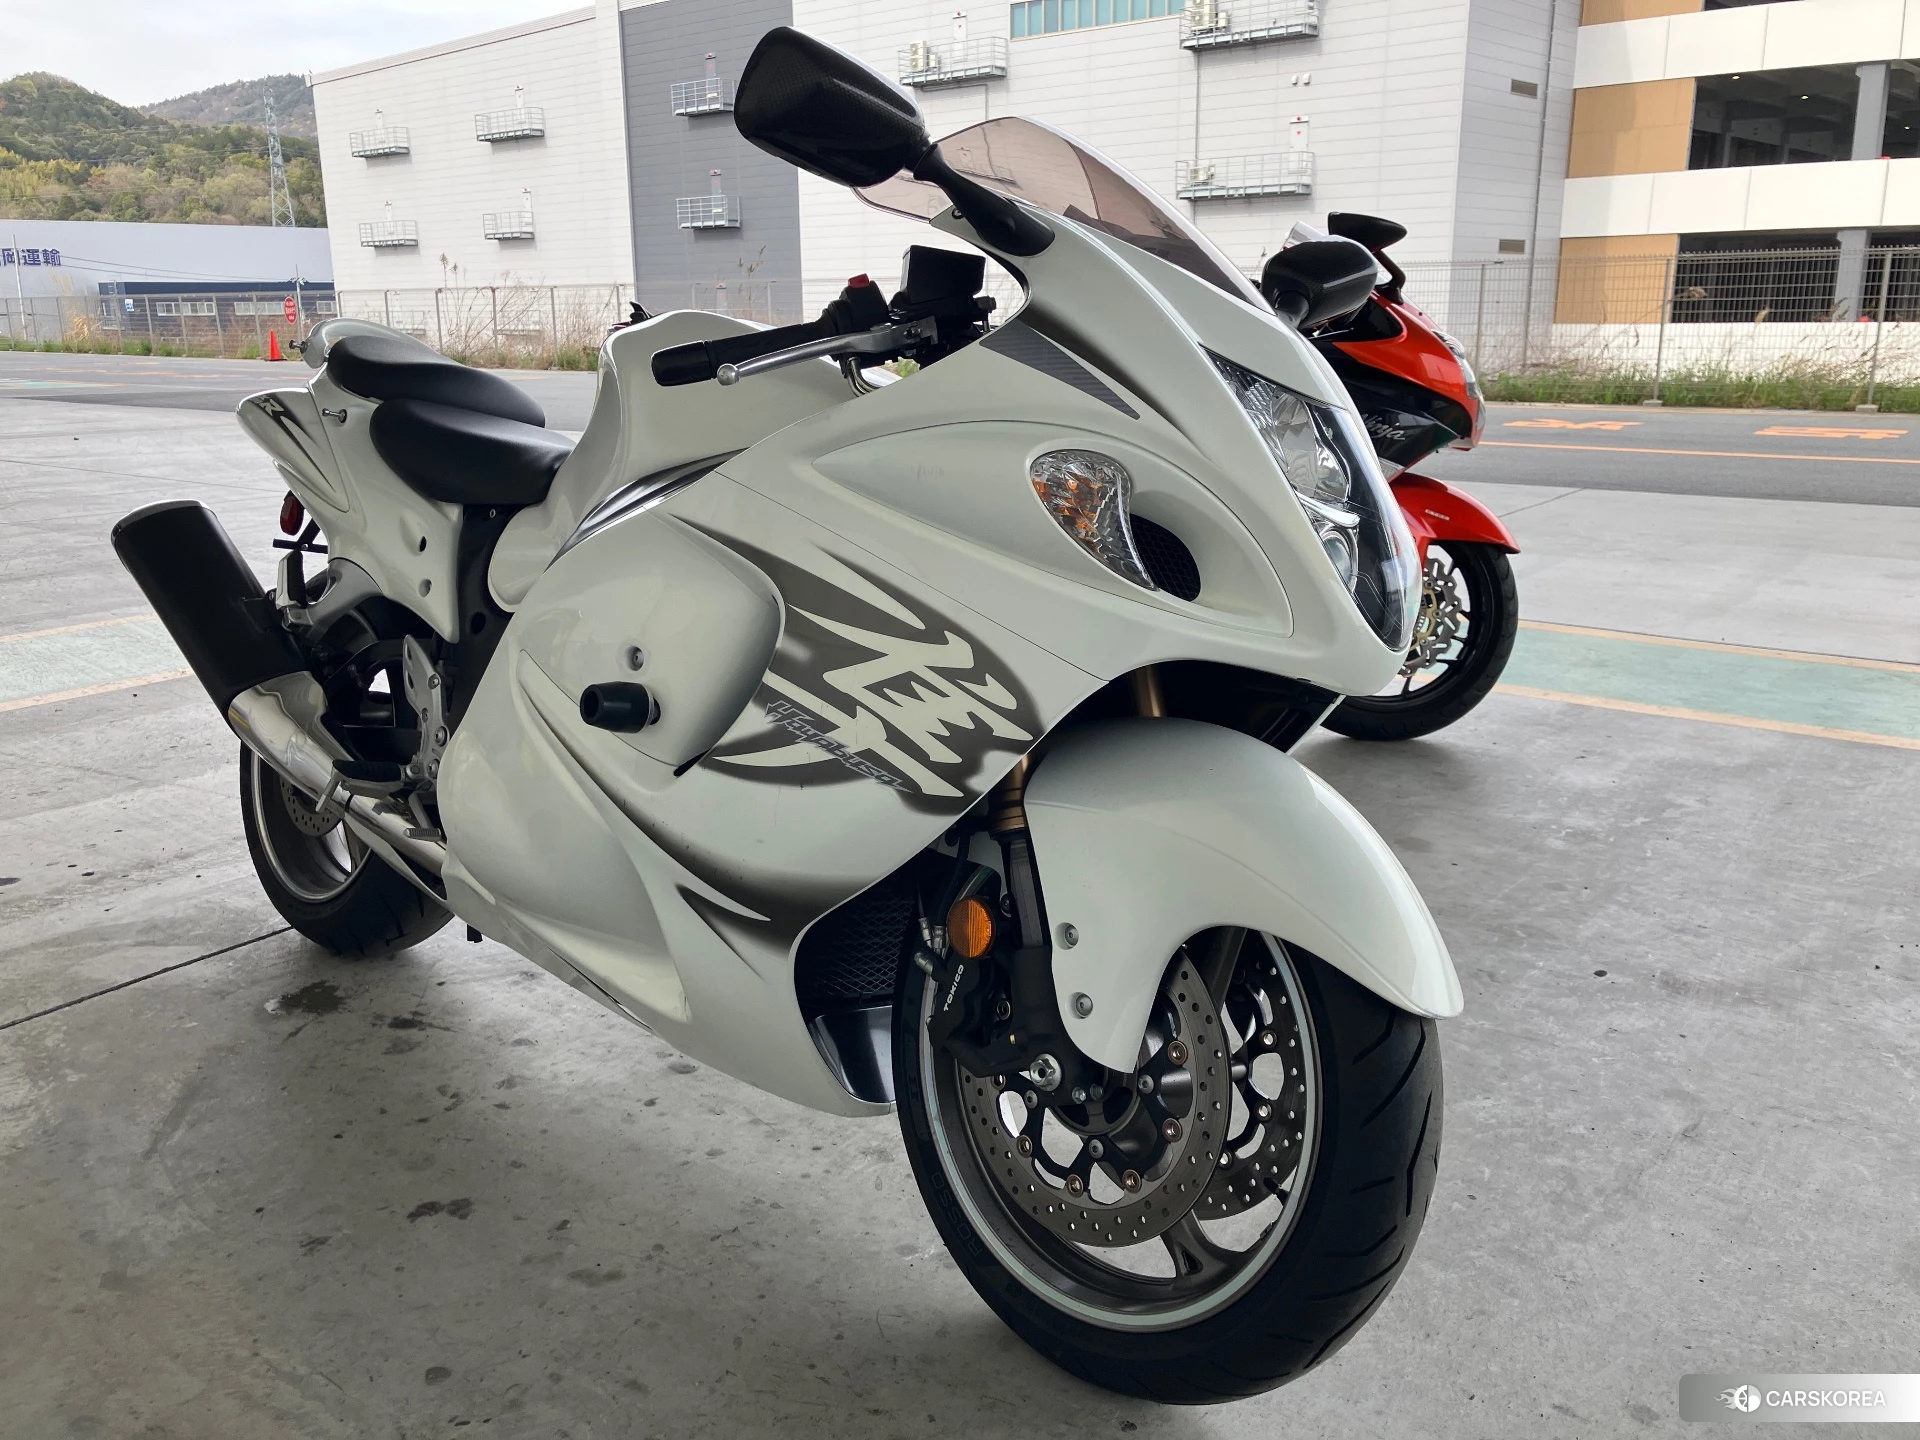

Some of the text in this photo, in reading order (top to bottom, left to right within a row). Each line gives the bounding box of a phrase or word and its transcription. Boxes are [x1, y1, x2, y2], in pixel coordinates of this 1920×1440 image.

[0, 248, 61, 266] 岡運輸
[943, 964, 964, 1011] TOKICO
[931, 1171, 983, 1258] ROSSO
